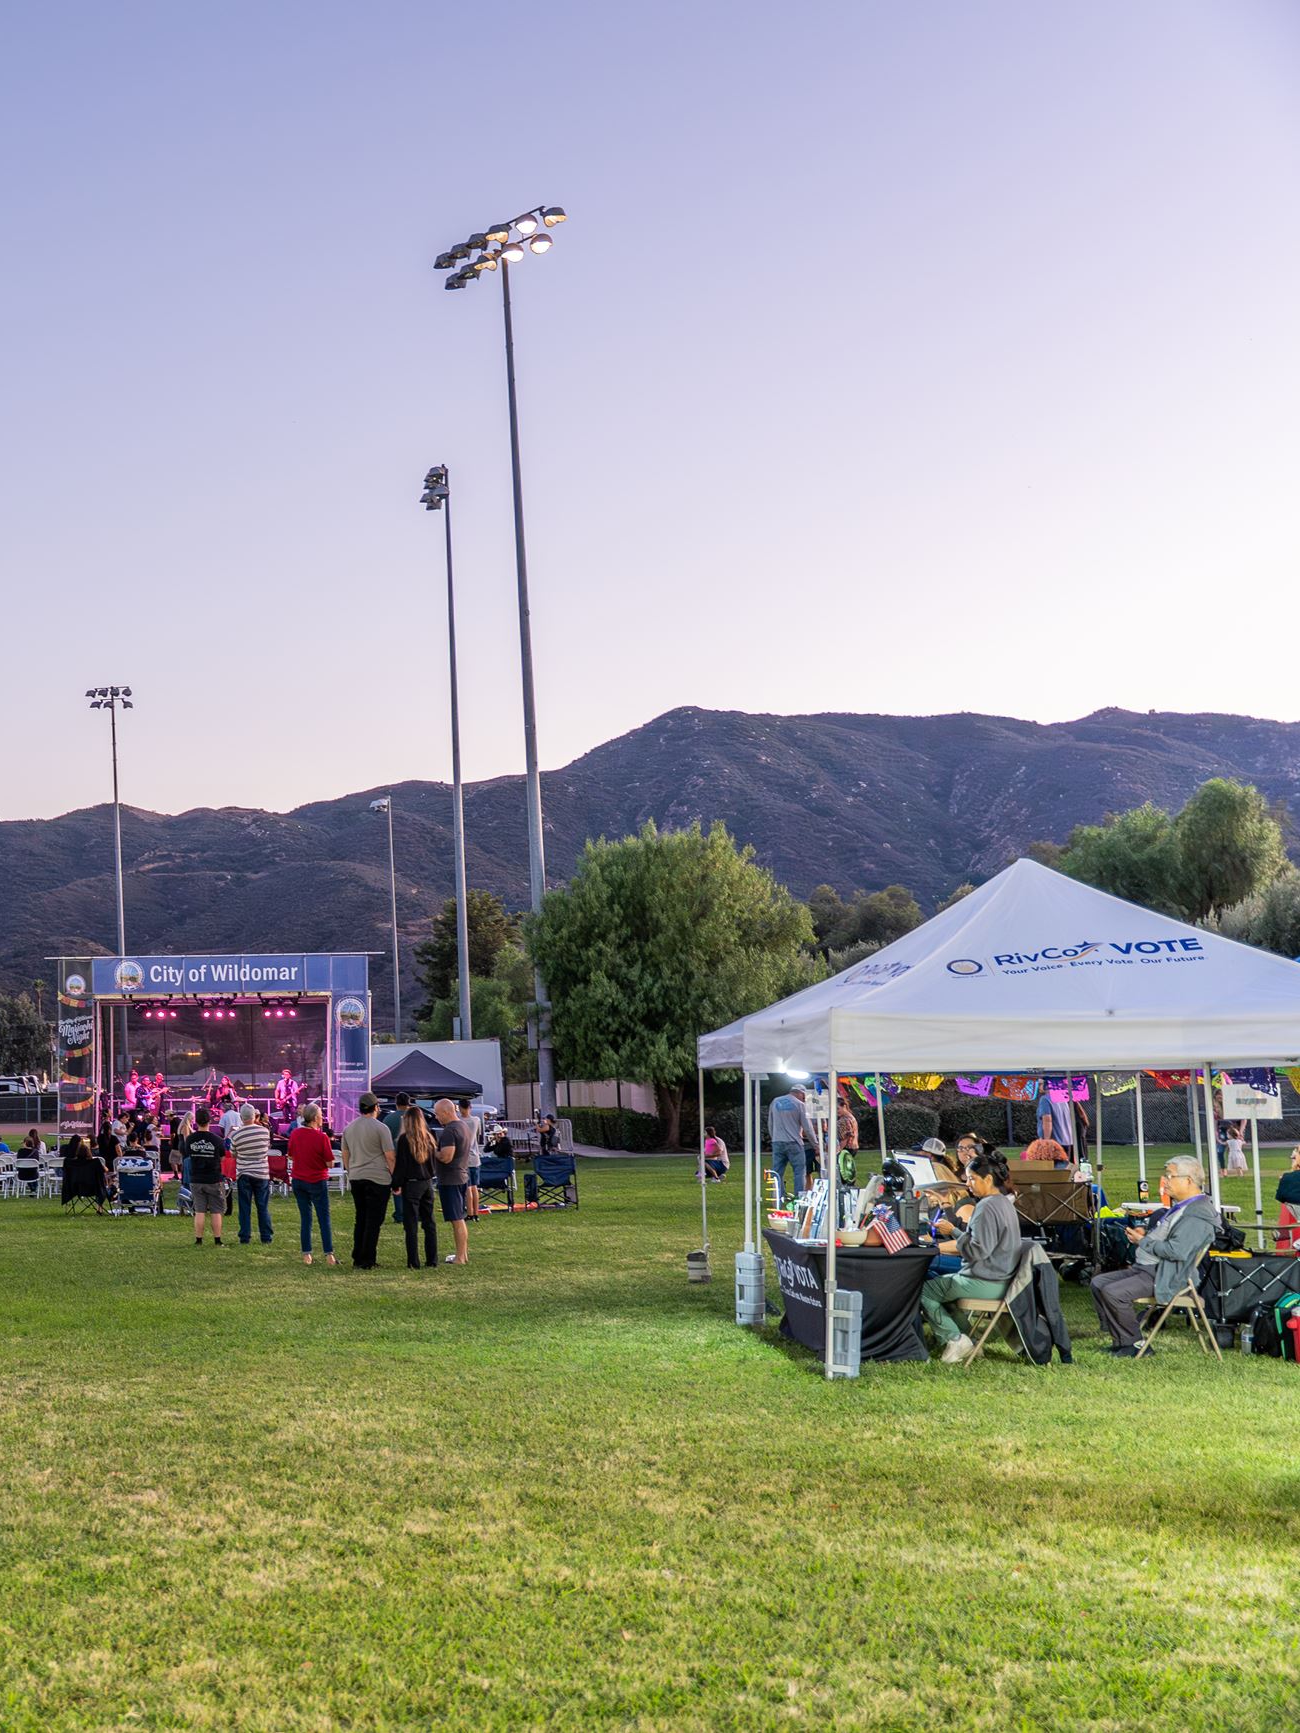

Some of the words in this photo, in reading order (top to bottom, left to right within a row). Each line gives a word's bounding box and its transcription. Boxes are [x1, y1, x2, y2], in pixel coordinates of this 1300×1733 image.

[993, 947, 1079, 966] RivCo
[1108, 937, 1203, 955] VOTE
[149, 964, 184, 986] City
[188, 964, 207, 982] of
[210, 963, 298, 982] Wildomar
